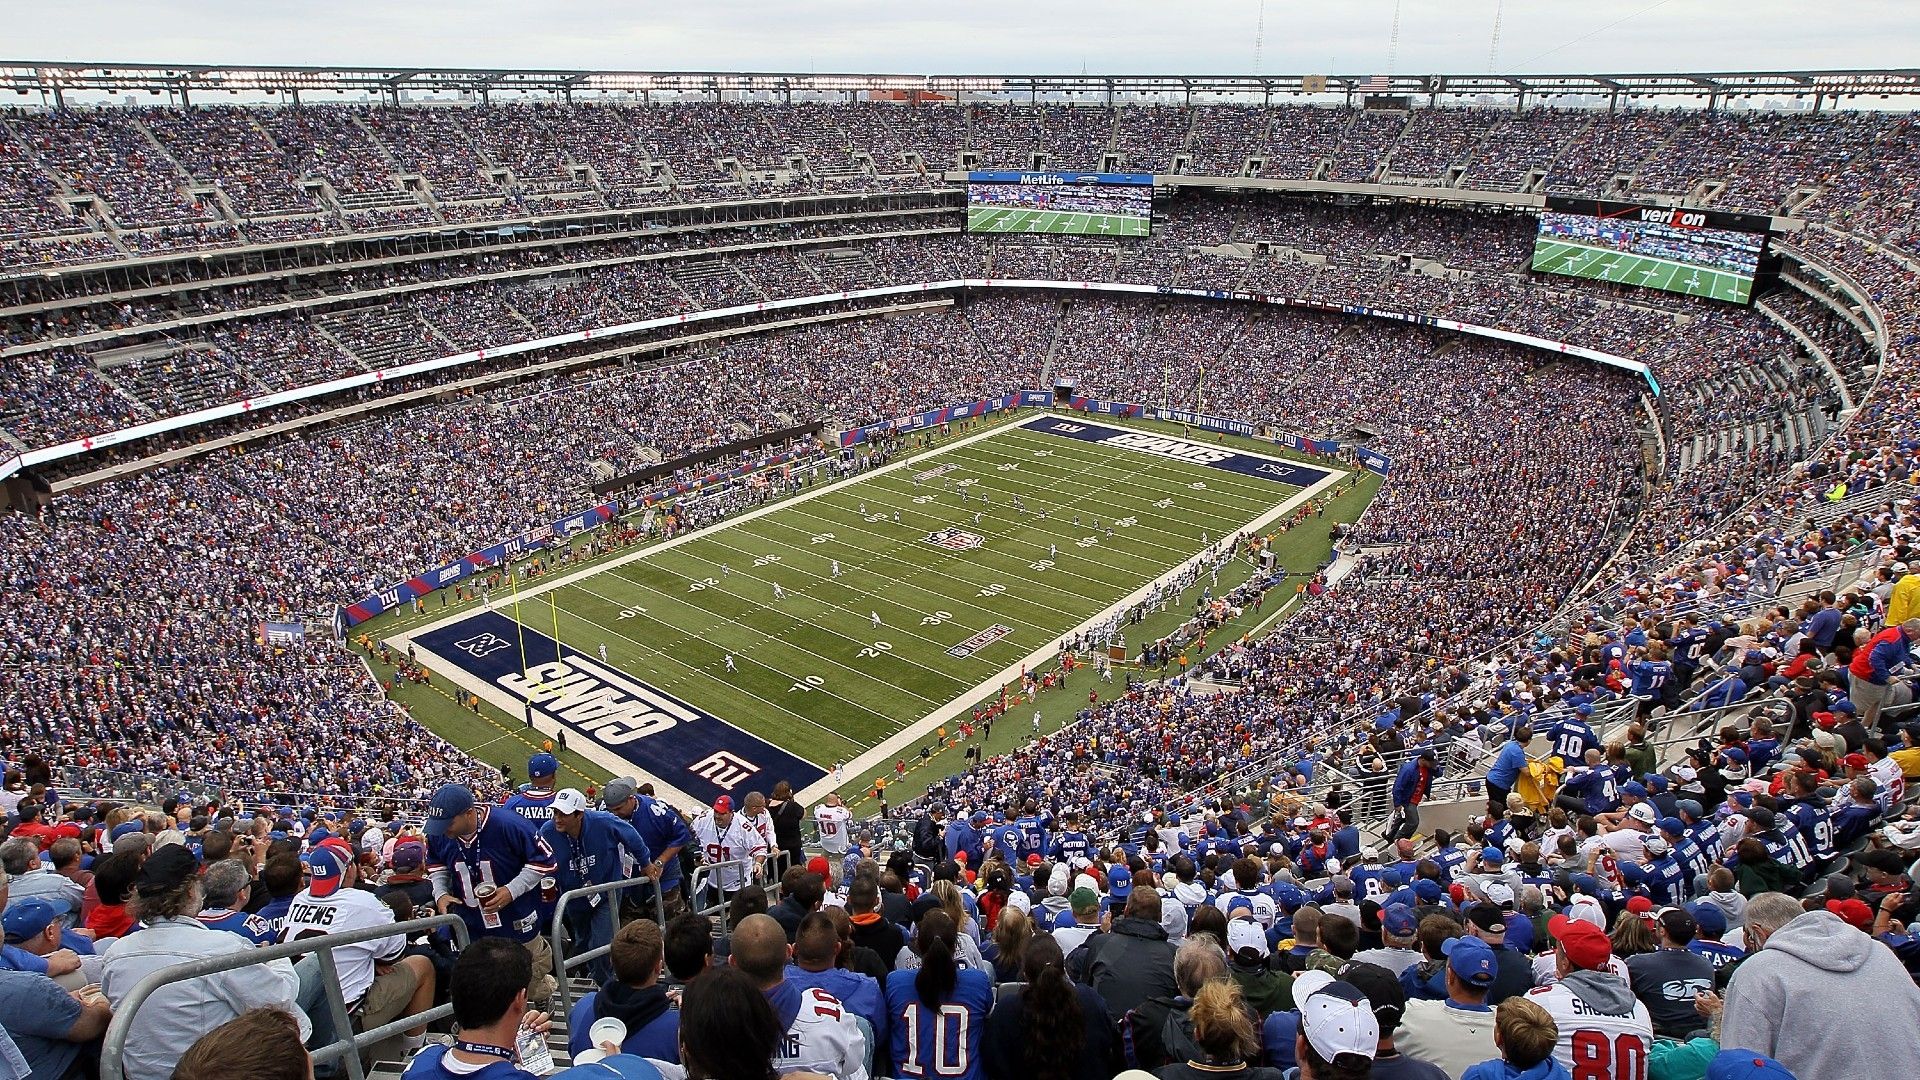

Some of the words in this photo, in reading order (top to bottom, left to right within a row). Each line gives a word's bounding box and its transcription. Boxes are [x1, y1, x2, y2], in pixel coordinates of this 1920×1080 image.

[1020, 174, 1064, 185] MetLife
[1641, 208, 1706, 228] verizon
[1097, 401, 1111, 413] ny
[1098, 433, 1236, 465] GIANTS
[1284, 434, 1296, 447] ny
[504, 540, 521, 554] ny
[439, 564, 461, 583] GIANTS
[1029, 559, 1055, 572] 50
[381, 589, 399, 610] ny
[983, 583, 1007, 597] 40
[927, 610, 953, 626] 30
[862, 641, 893, 658] 20
[794, 675, 825, 693] 10
[497, 659, 679, 745] GIANTS
[1556, 733, 1583, 758] 10
[688, 750, 761, 791] ny
[1814, 817, 1834, 851] 91
[707, 843, 732, 866] 91
[313, 865, 327, 876] ny
[288, 903, 338, 926] TOEWS
[811, 988, 842, 1023] 10
[902, 1003, 970, 1076] 10
[1571, 1029, 1646, 1080] 80
